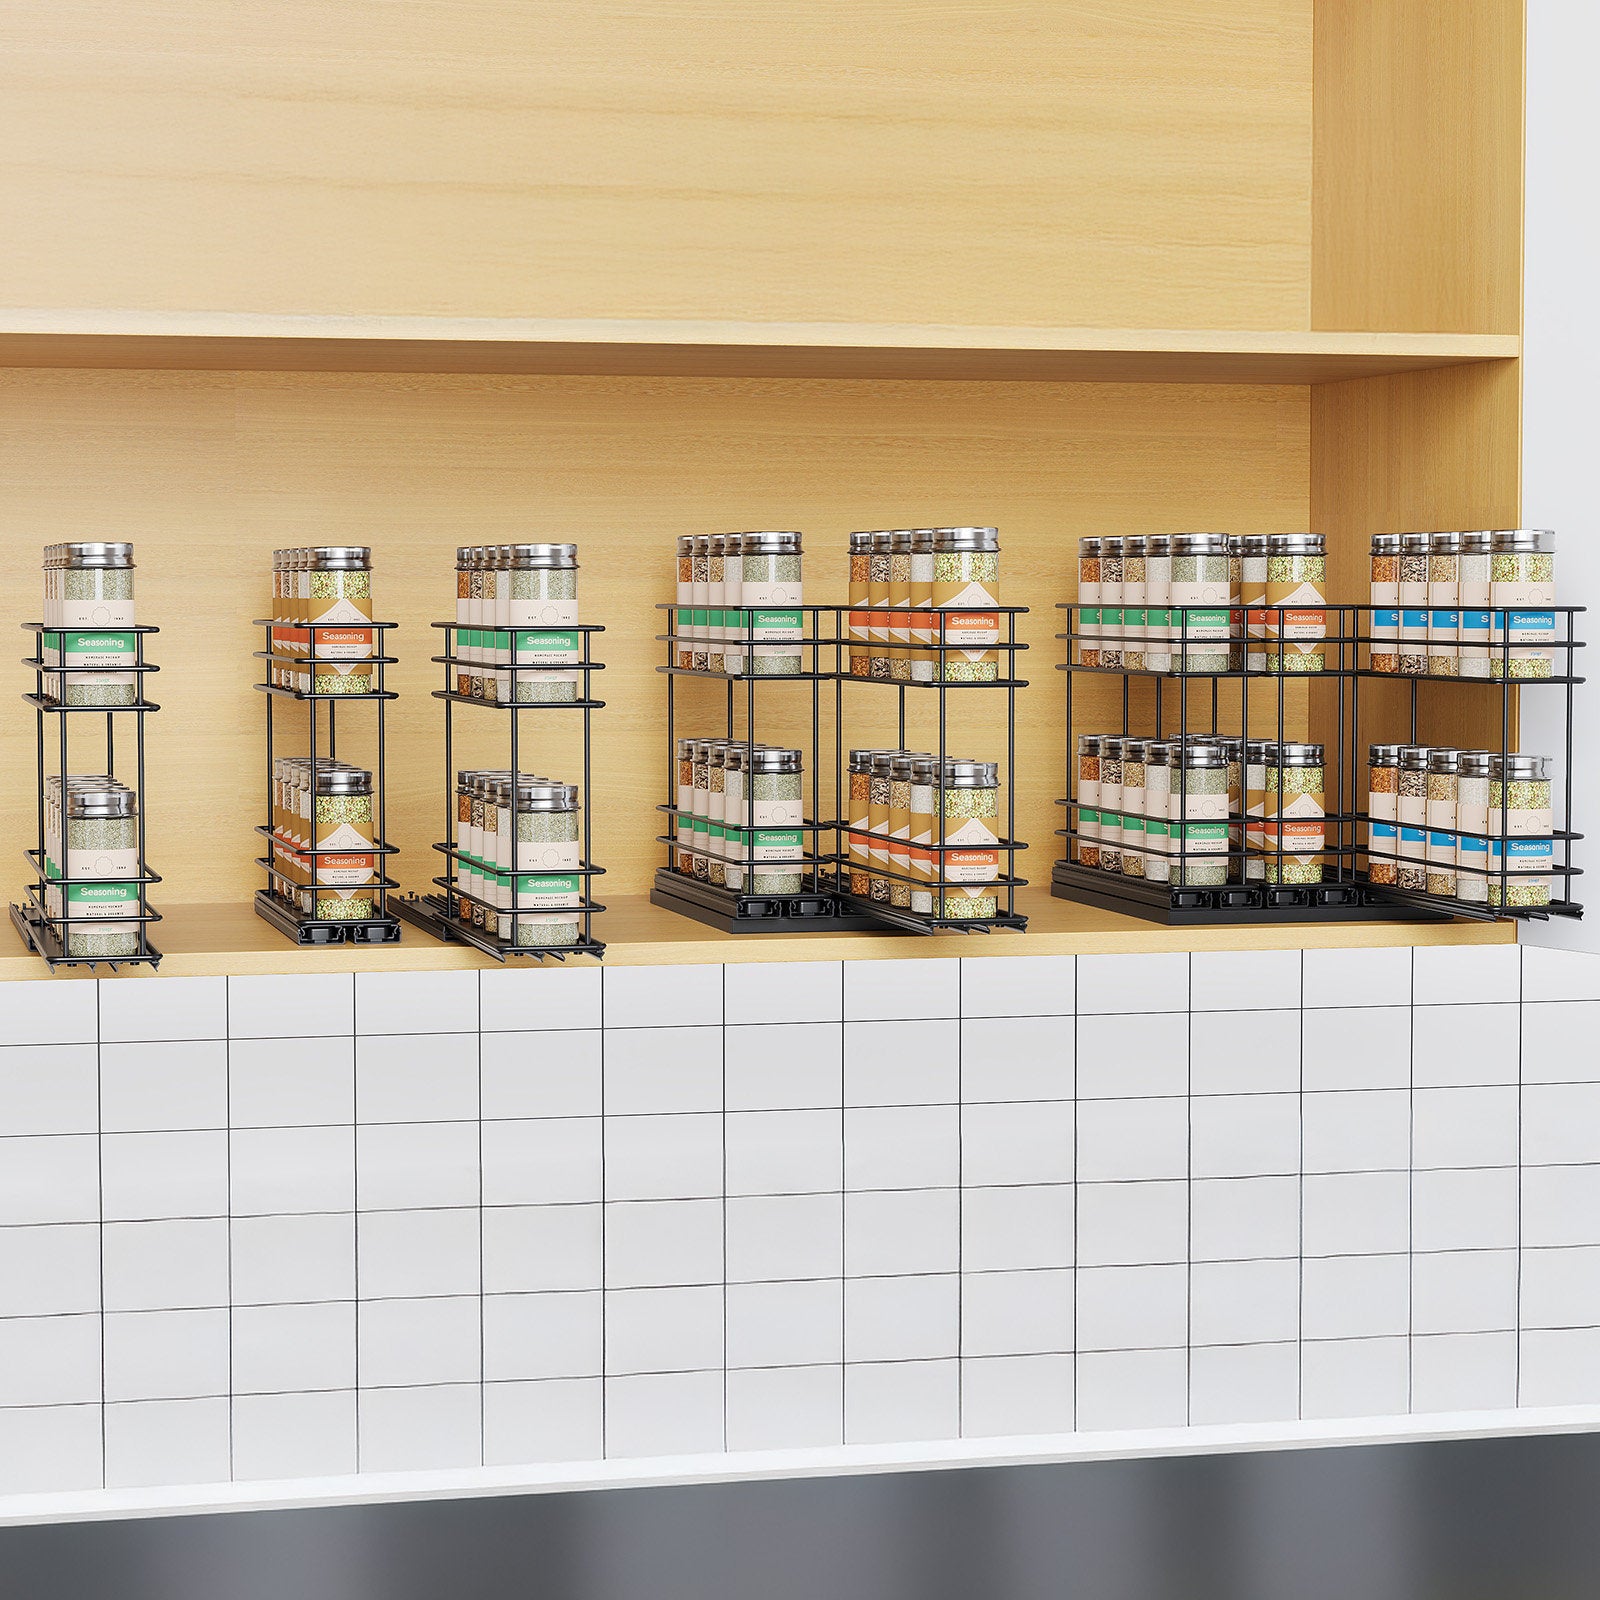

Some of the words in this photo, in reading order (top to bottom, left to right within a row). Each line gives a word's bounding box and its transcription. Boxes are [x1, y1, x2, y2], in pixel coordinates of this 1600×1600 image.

[758, 615, 797, 624] Seasoning
[952, 617, 994, 627] Seasoning
[1189, 614, 1226, 623] Seasoning
[1286, 614, 1322, 622] Seasoning
[1513, 616, 1552, 625] Seasoning
[322, 632, 364, 641] Seasoning
[527, 636, 570, 646] Seasoning
[78, 638, 124, 648] Seasoning
[1188, 827, 1224, 835] Seasoning
[1285, 825, 1321, 833] Seasoning
[759, 834, 797, 842] Seasoning
[1511, 843, 1550, 852] Seasoning
[324, 857, 366, 865] Seasoning
[951, 853, 993, 862] Seasoning
[528, 879, 571, 888] Seasoning
[80, 888, 127, 897] Seasoning
